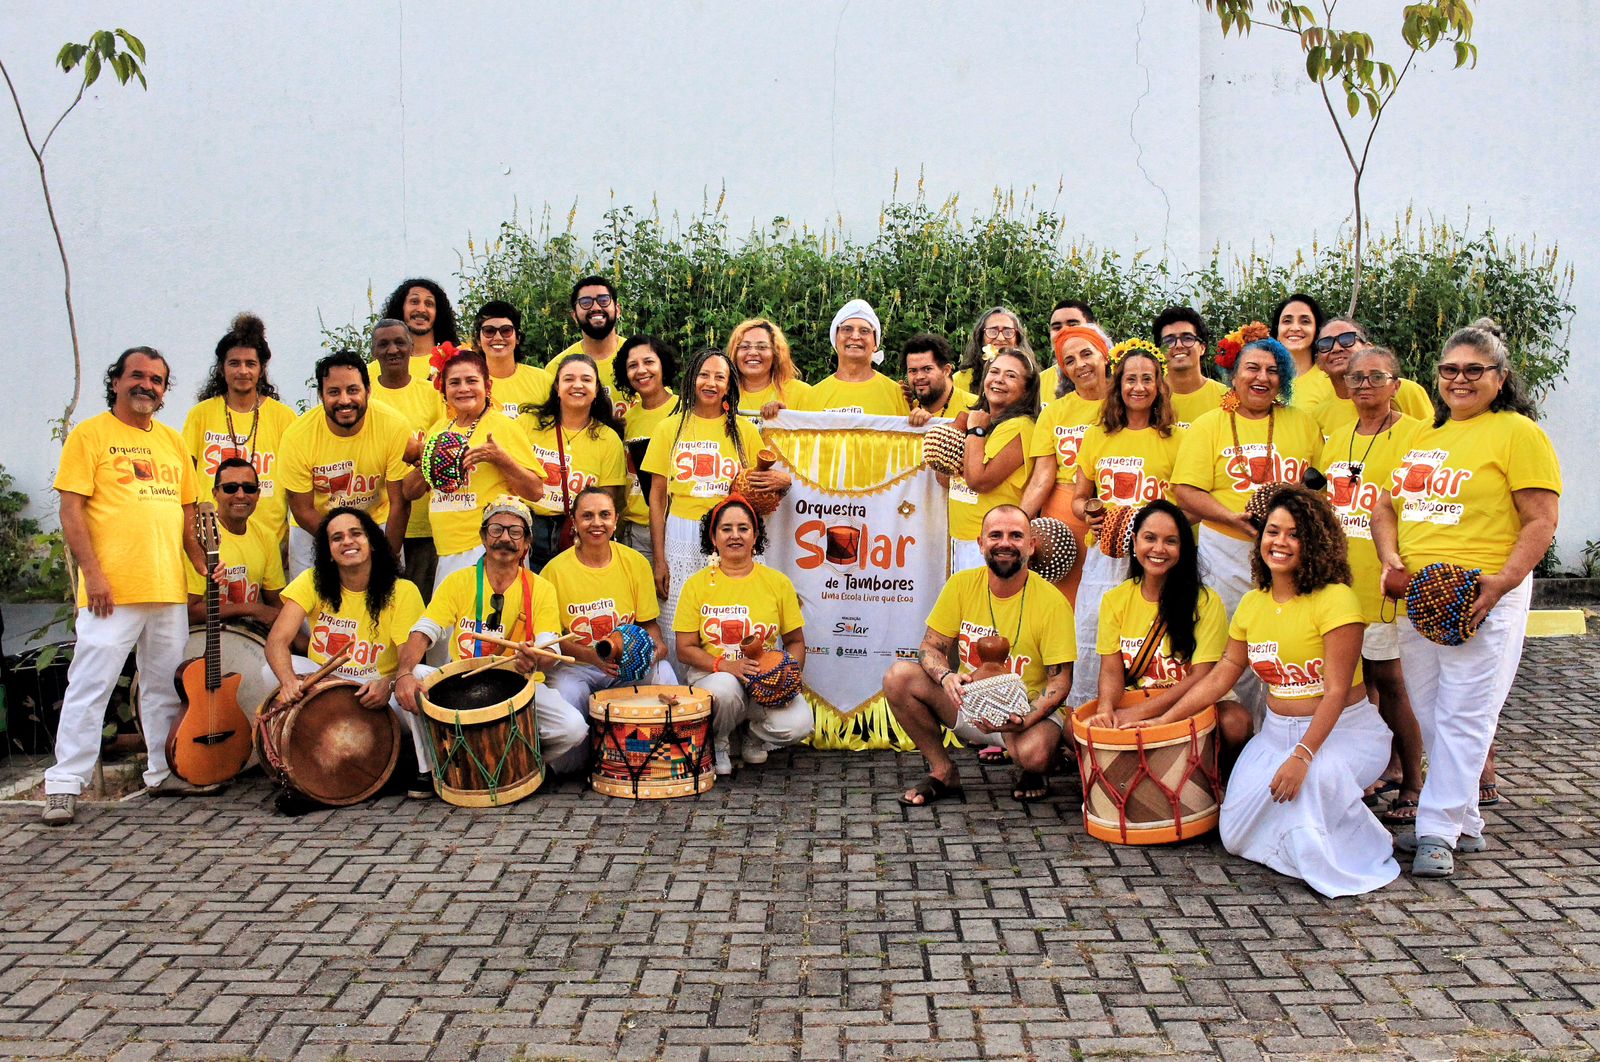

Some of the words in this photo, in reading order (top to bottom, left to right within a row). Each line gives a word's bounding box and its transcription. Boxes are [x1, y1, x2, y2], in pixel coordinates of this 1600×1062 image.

[109, 446, 152, 455] Orquestra
[795, 499, 867, 519] Orquestra
[795, 520, 916, 571] Solar
[825, 577, 839, 589] de
[844, 573, 914, 592] Tambores
[821, 592, 839, 600] Uma
[841, 592, 862, 601] Escola
[864, 593, 880, 602] Livre
[881, 596, 896, 604] que
[568, 599, 614, 615] Orquestra
[701, 605, 748, 617] Orquestra
